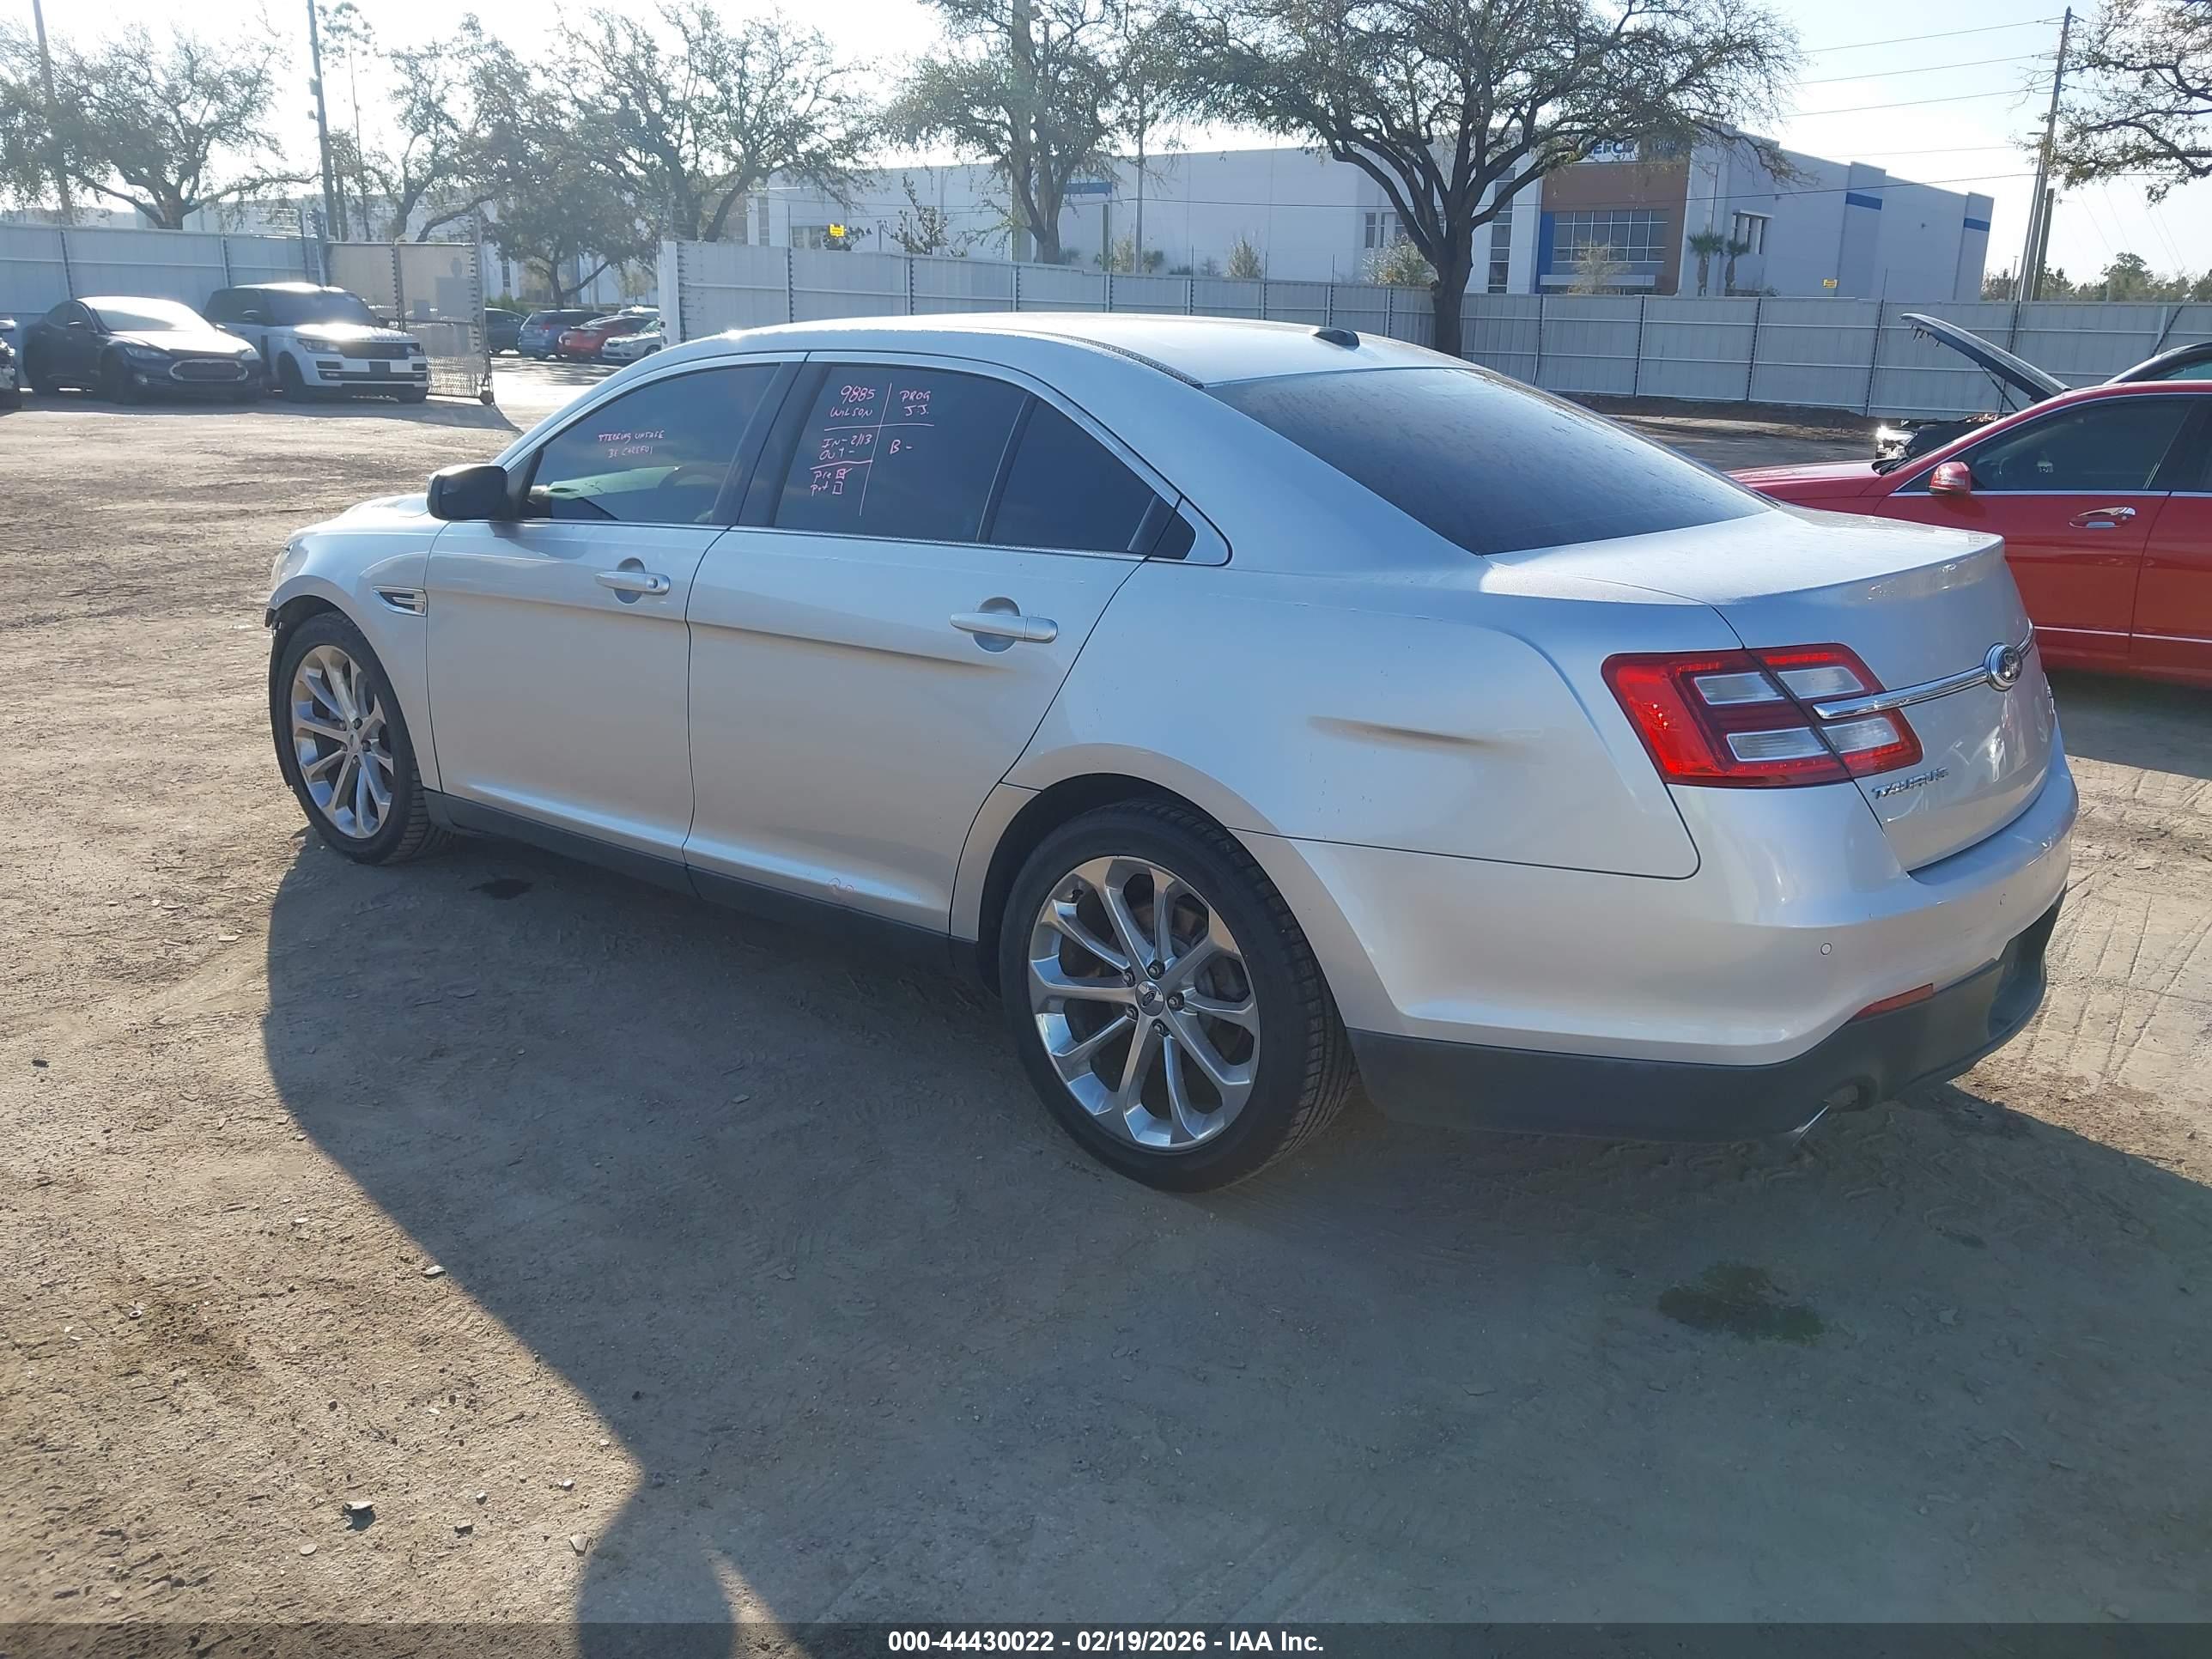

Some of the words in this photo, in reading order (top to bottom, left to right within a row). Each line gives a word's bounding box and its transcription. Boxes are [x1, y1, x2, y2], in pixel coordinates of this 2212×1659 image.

[840, 385, 876, 404] 9885
[899, 390, 931, 402] PROG
[830, 406, 873, 418] WILSON
